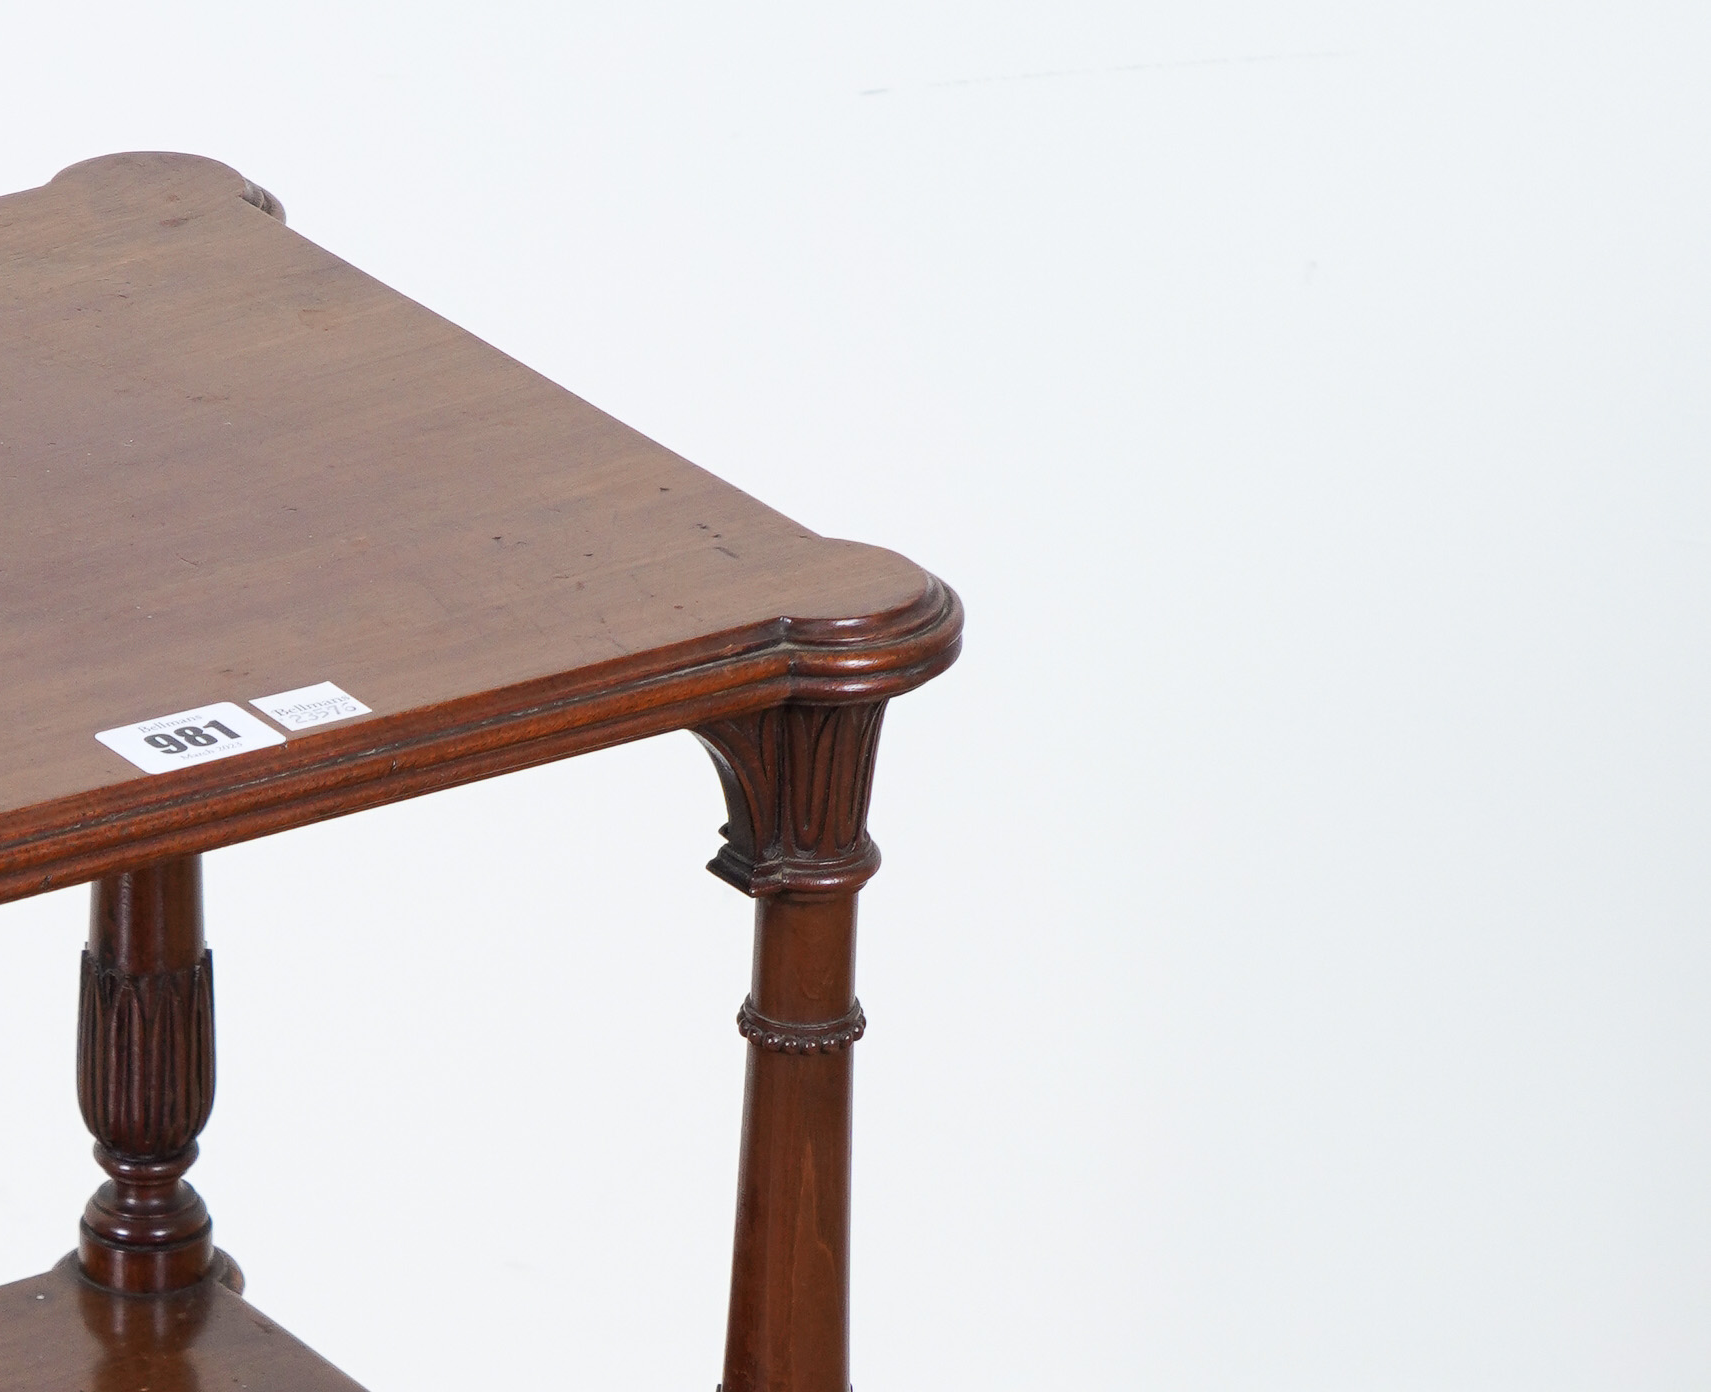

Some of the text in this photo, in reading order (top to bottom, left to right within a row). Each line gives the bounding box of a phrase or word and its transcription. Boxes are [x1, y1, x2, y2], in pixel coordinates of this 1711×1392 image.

[272, 695, 350, 717] Bellmans
[137, 712, 203, 733] Bellmans
[143, 719, 242, 755] 981
